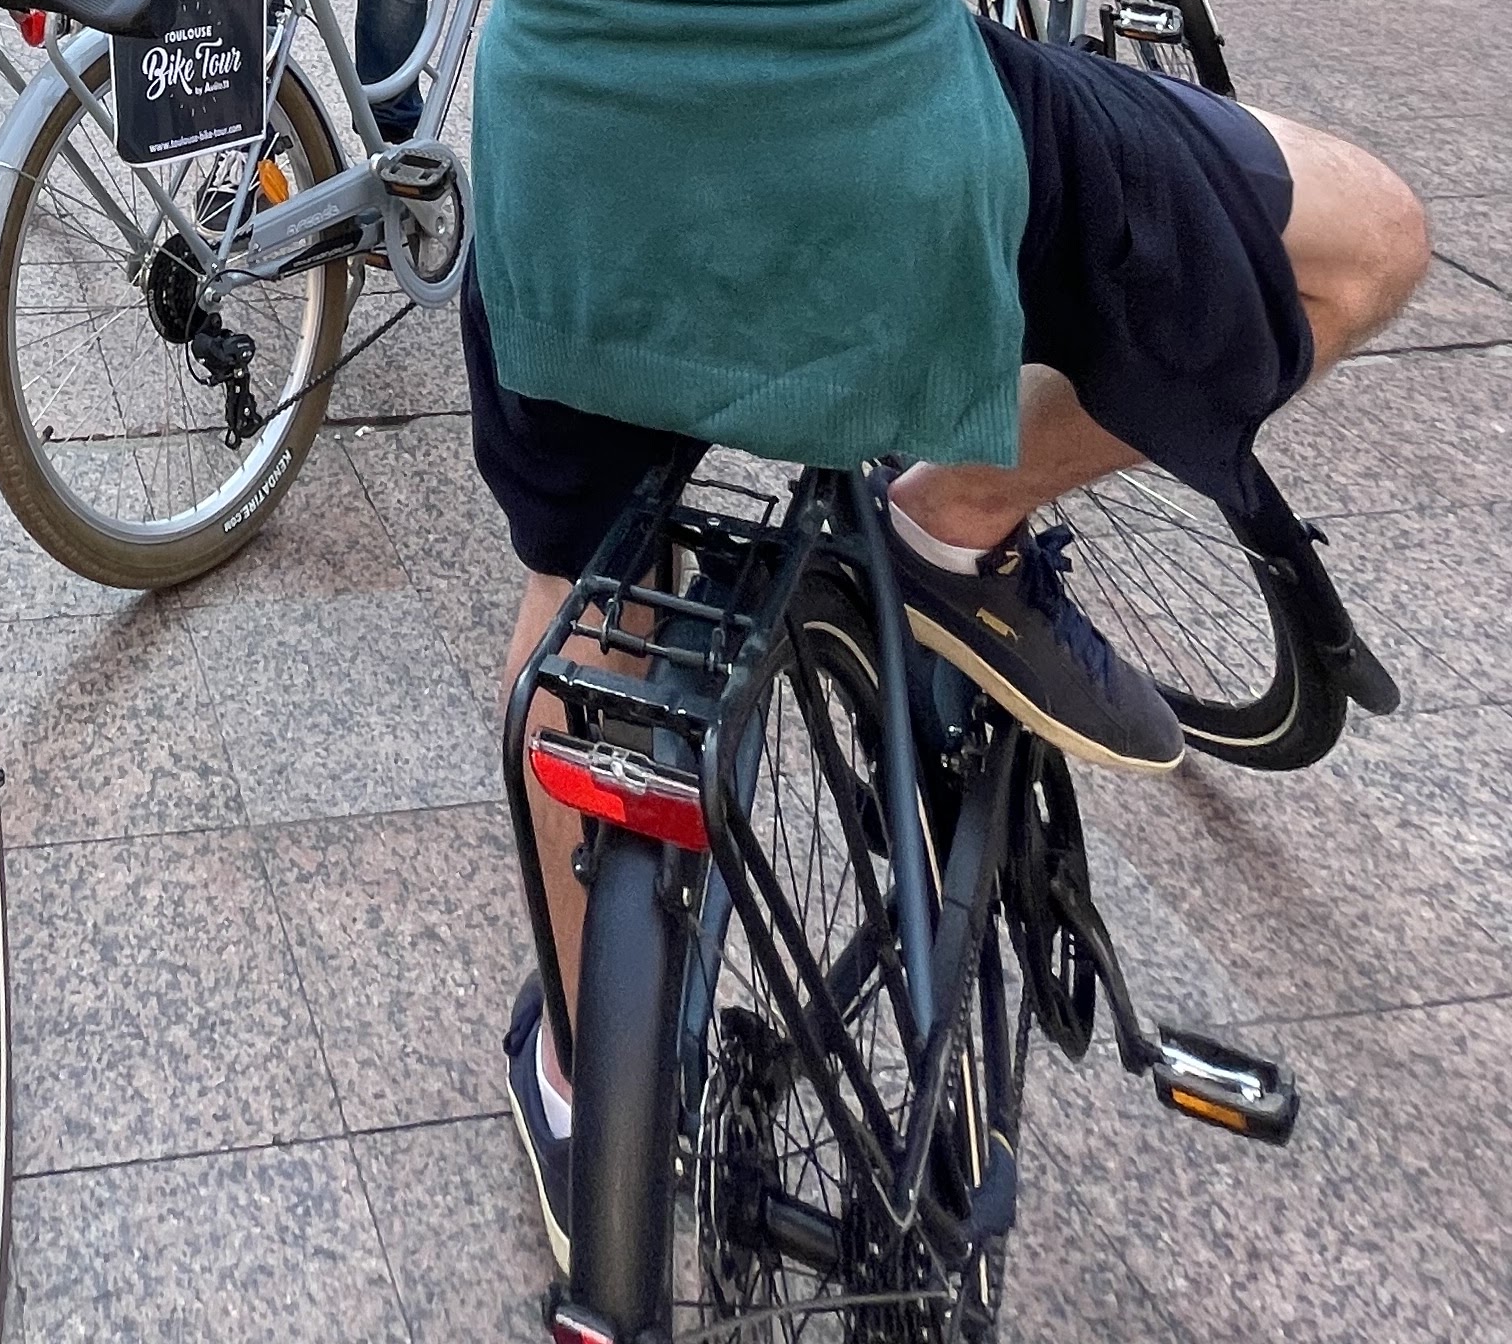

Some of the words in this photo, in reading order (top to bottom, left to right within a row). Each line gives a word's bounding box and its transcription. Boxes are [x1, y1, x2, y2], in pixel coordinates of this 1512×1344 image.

[164, 25, 212, 44] TOULOUSE
[142, 46, 195, 101] Bike
[195, 37, 242, 80] Tour
